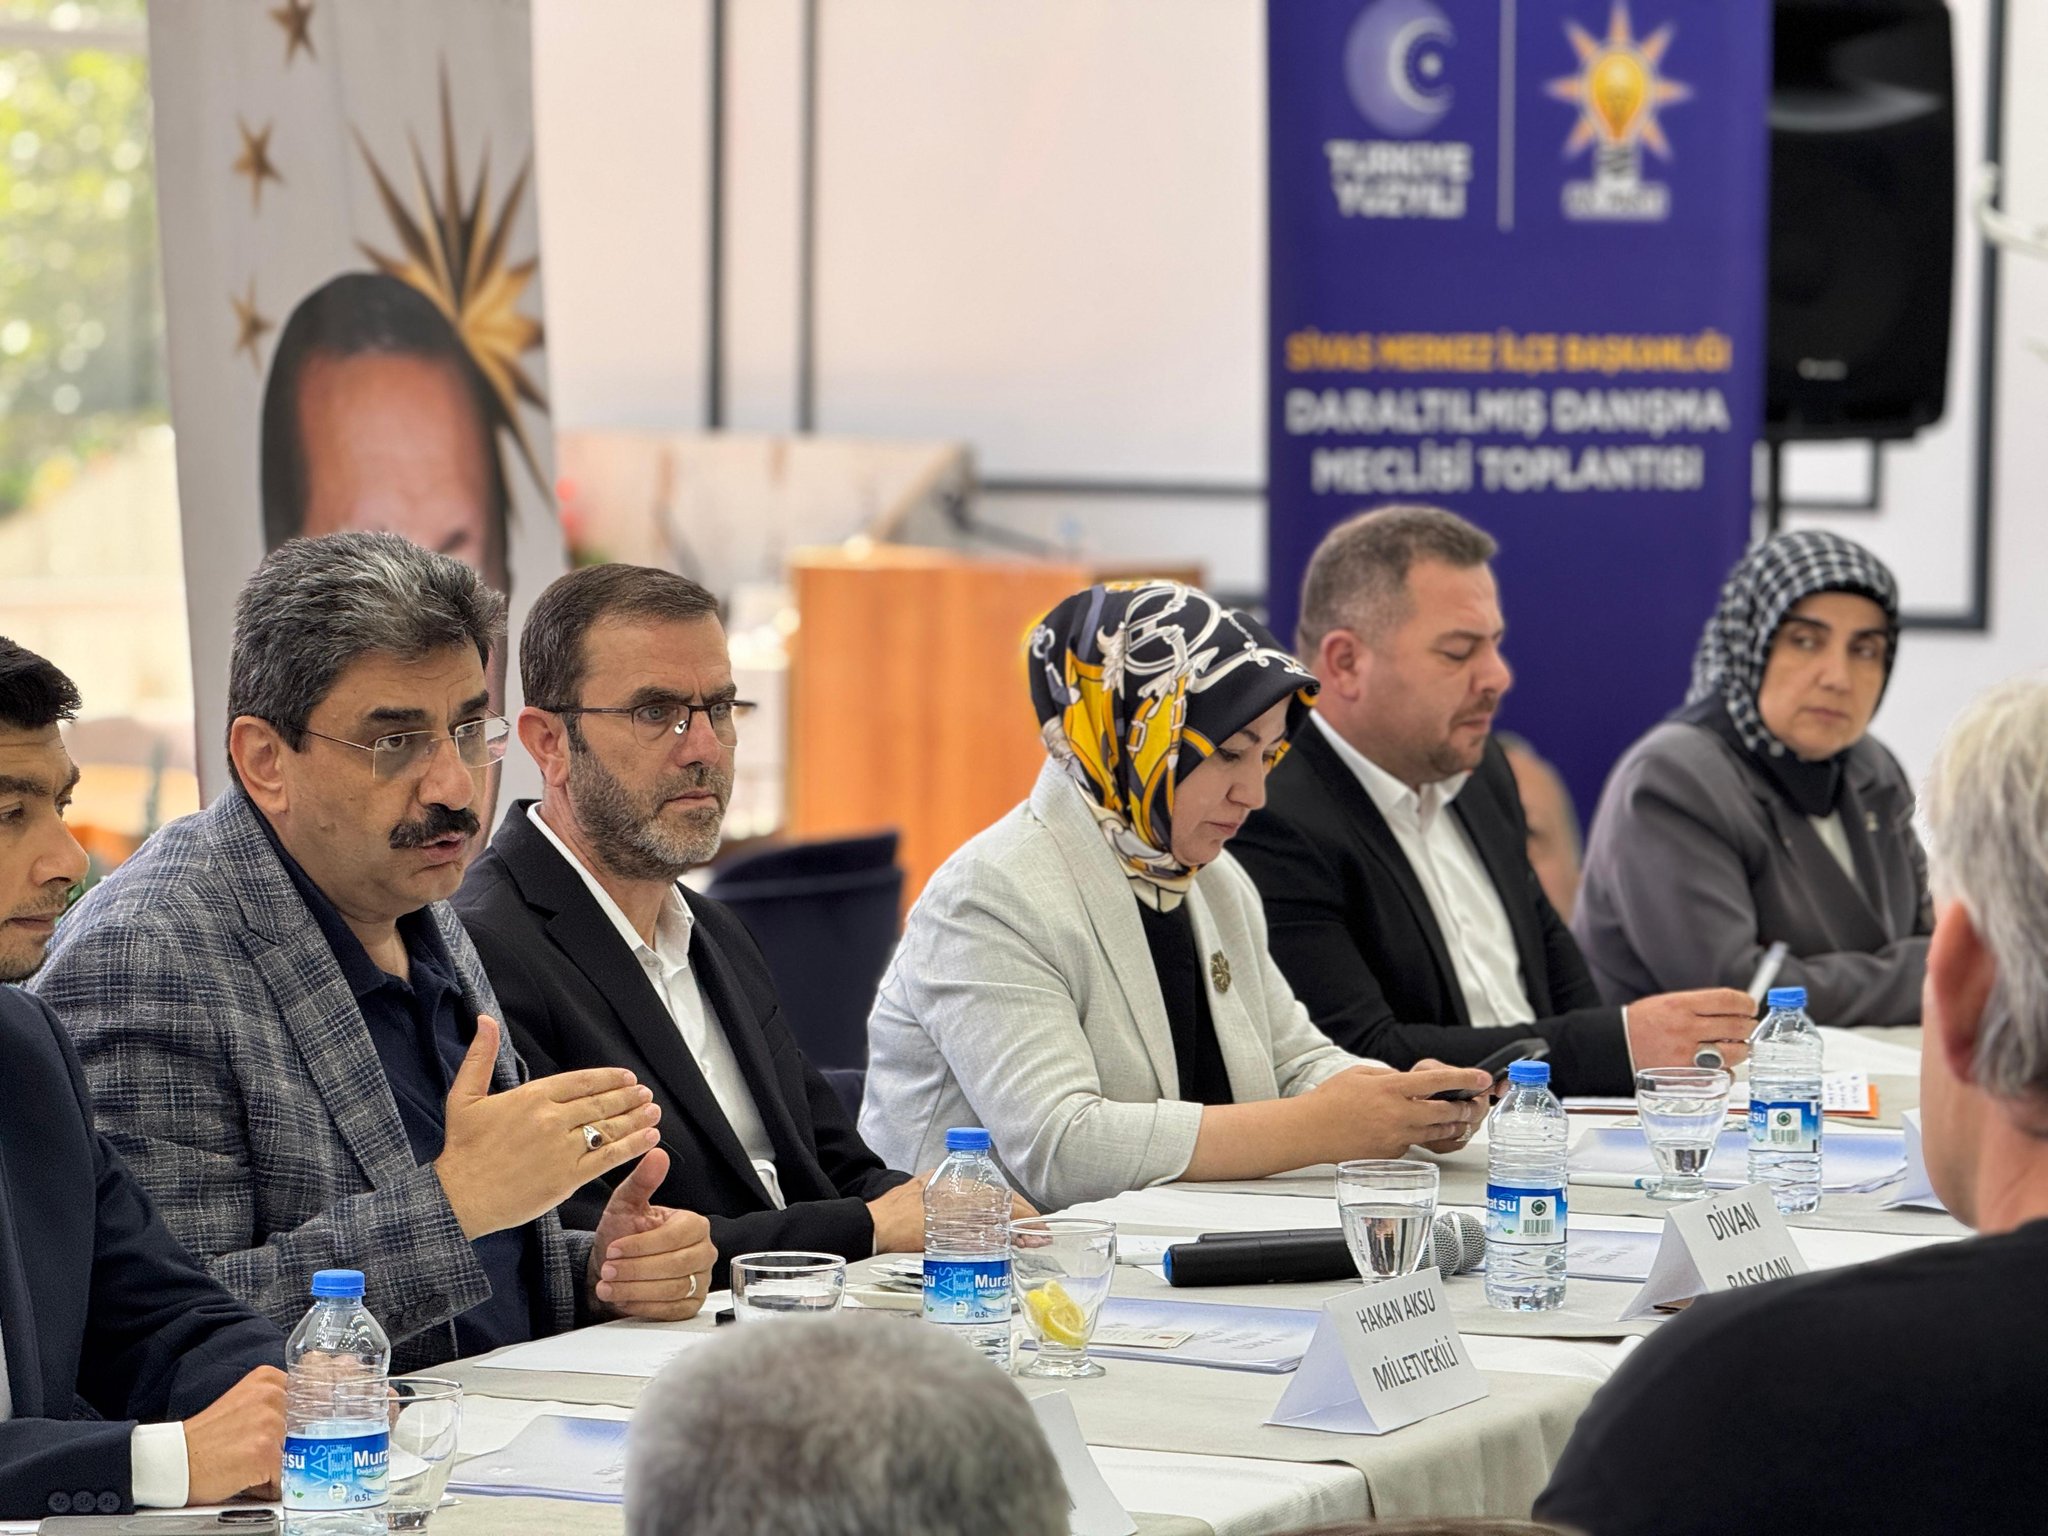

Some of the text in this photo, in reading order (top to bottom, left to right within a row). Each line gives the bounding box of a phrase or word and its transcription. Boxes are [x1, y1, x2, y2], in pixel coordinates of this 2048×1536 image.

[1286, 388, 1731, 438] DARALTILMIŞ DANIŞMA
[1312, 439, 1703, 492] MECLİSİ TOPLANTISI
[1706, 1202, 1761, 1241] DİVAN
[1356, 1288, 1436, 1334] HAKAN AKSU
[1372, 1336, 1459, 1392] MİLLETVEKİLİ
